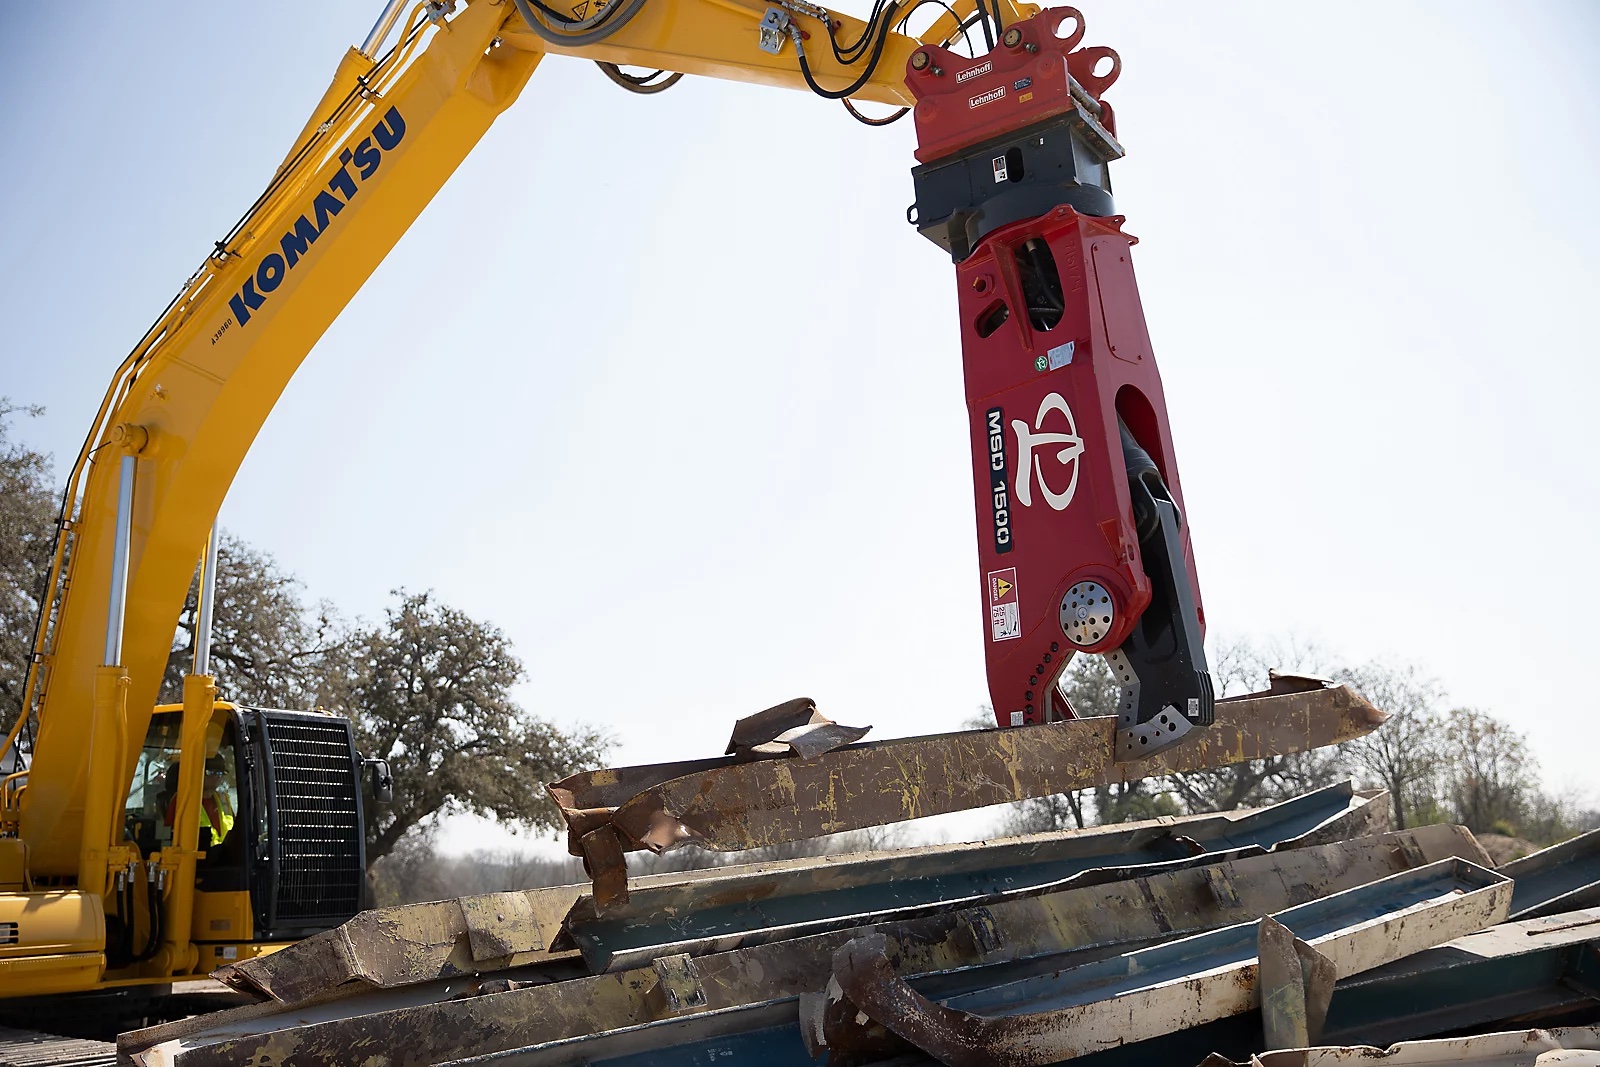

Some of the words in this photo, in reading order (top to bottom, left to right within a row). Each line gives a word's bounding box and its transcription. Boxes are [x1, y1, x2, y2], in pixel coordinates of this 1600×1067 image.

[957, 62, 992, 82] Lehnhoff
[970, 88, 1004, 107] Lehnhoff
[228, 105, 406, 328] KOMATSU
[988, 410, 1004, 471] MSD
[994, 480, 1010, 544] 1500
[993, 607, 999, 618] 75
[999, 606, 1005, 617] 25
